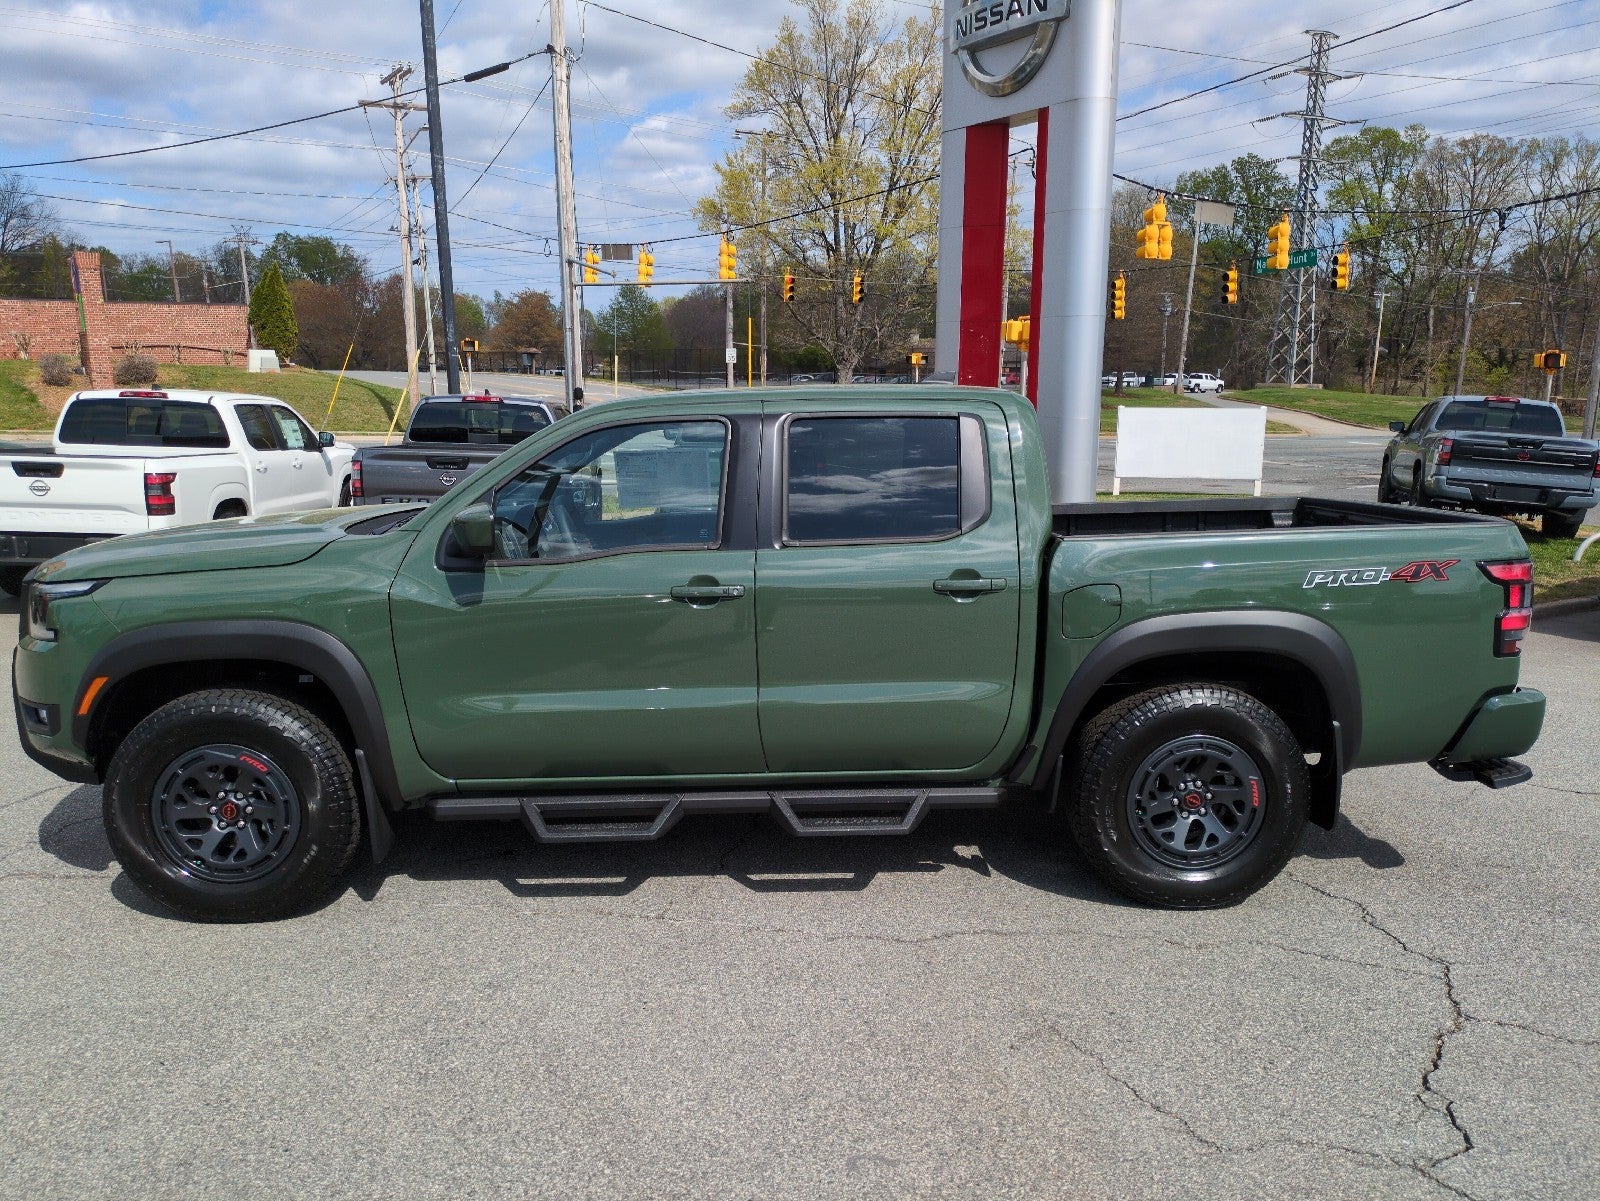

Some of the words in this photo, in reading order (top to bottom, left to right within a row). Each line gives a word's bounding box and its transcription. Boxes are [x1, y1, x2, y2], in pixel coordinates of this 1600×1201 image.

[956, 0, 1048, 40] NISSAN
[1302, 559, 1461, 588] PRO-4X
[239, 755, 269, 772] PRO
[1250, 780, 1259, 807] PRO
